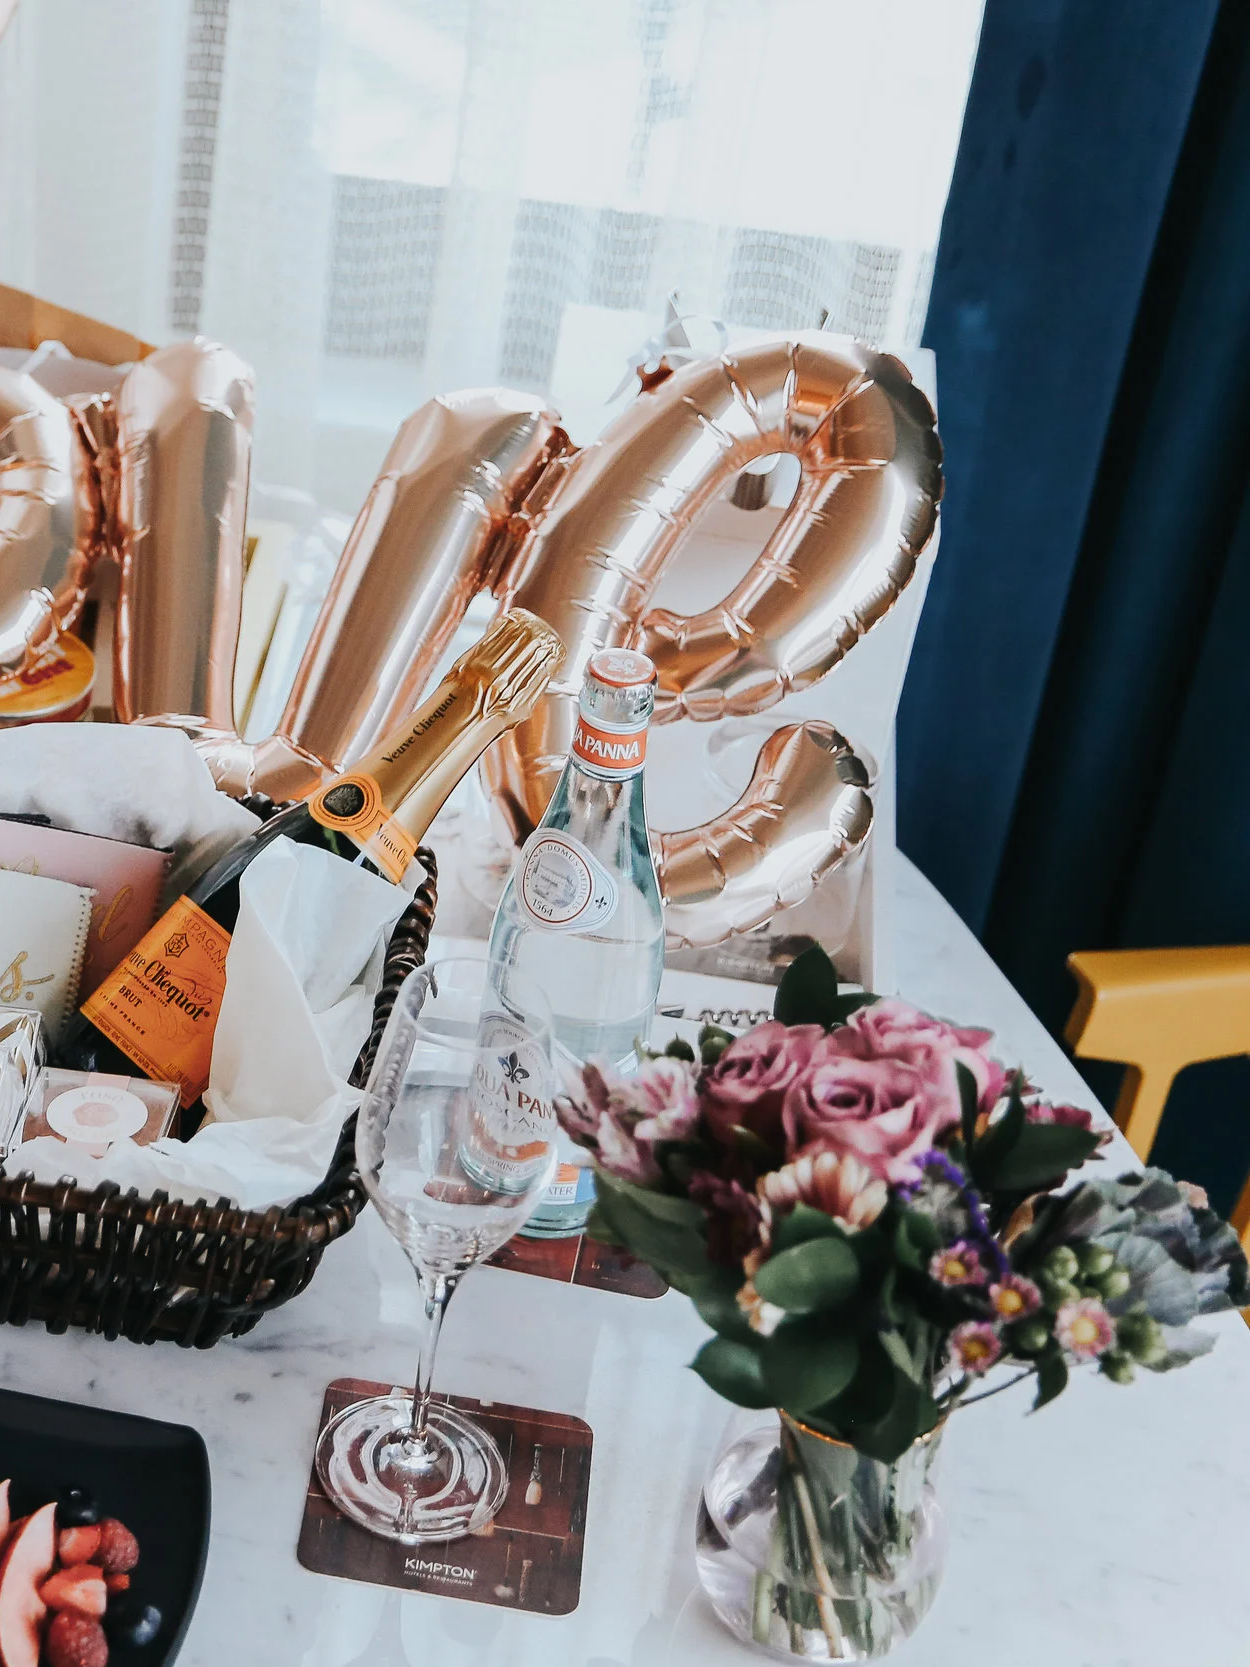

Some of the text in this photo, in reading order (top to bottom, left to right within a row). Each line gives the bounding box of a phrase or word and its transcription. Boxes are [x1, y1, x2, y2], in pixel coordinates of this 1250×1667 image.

[381, 692, 458, 764] Veuve Clicquot
[583, 738, 641, 760] PANNA
[546, 843, 579, 867] DOMUS
[531, 898, 554, 917] 1564
[118, 985, 143, 1008] BRUT
[118, 1010, 146, 1036] FRANCE
[476, 1063, 552, 1120] QUA PAN
[405, 1557, 475, 1579] KIMPTON
